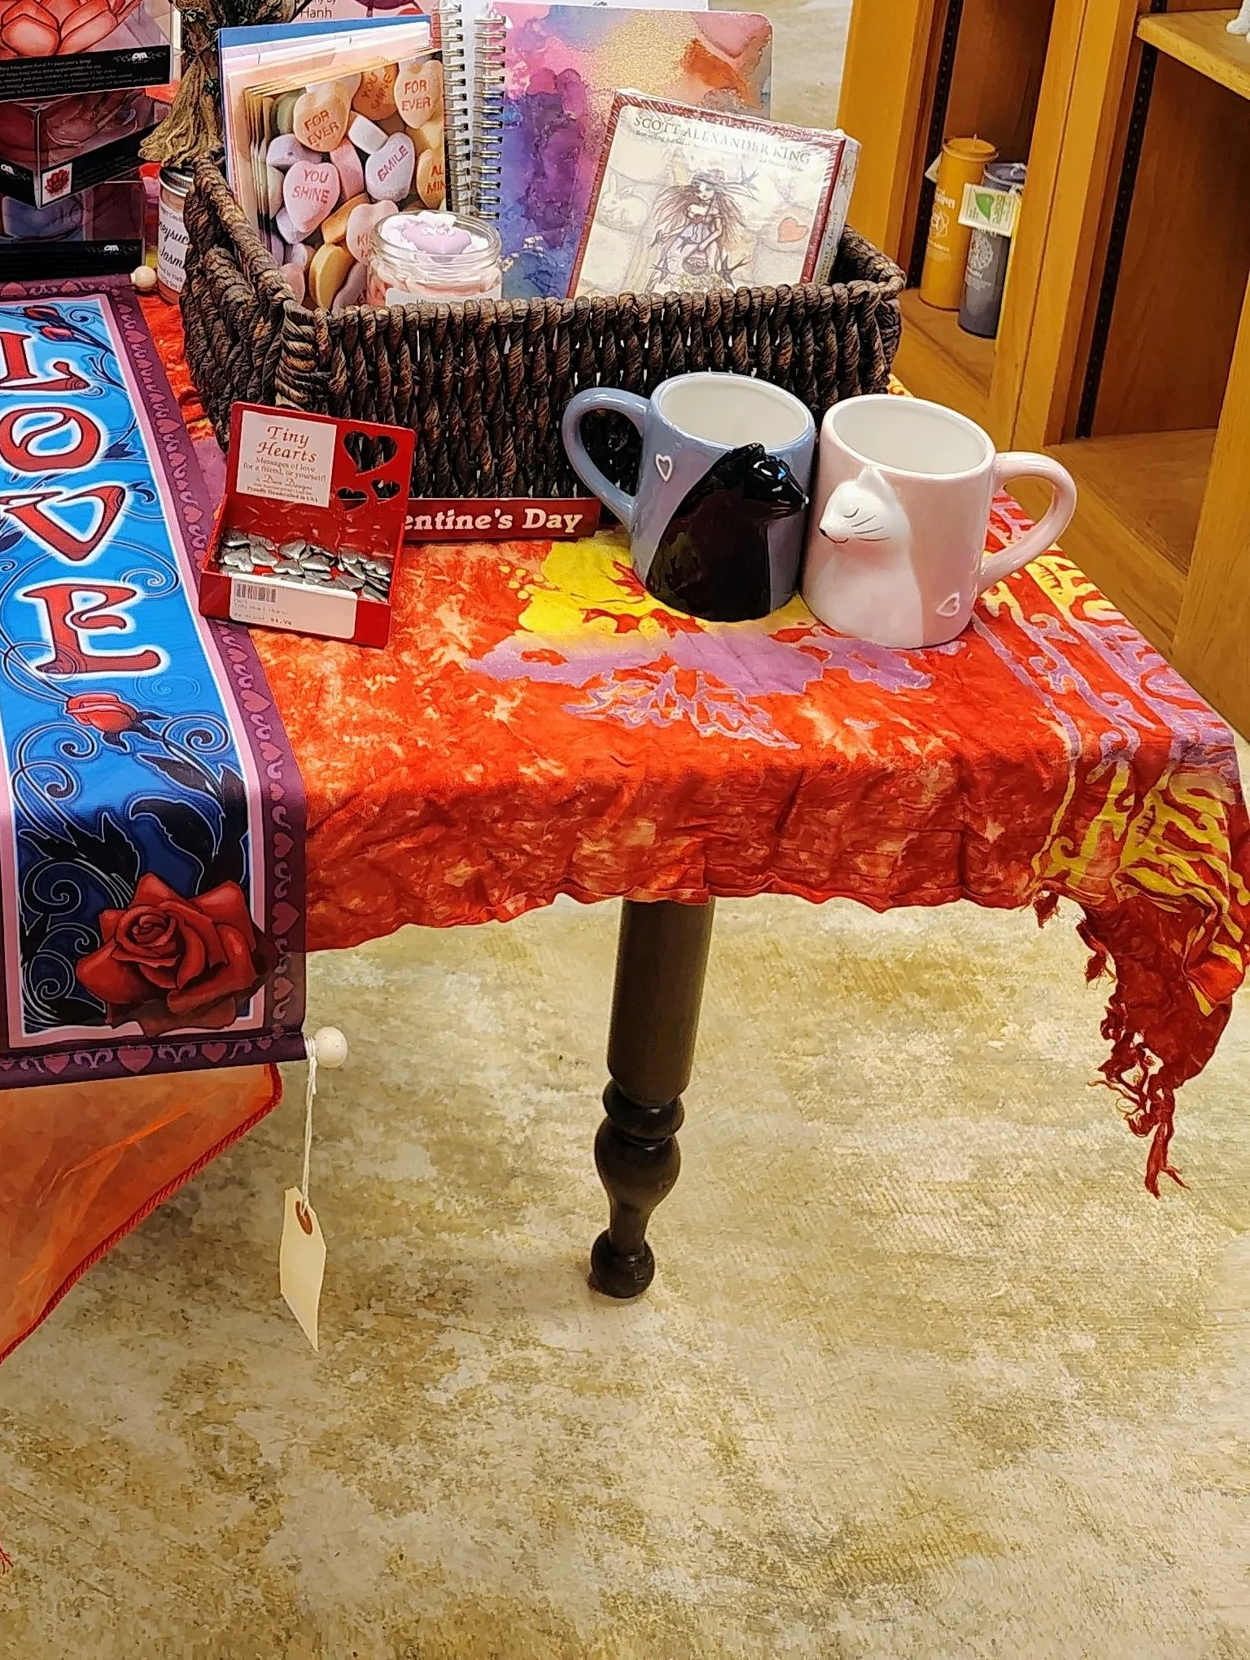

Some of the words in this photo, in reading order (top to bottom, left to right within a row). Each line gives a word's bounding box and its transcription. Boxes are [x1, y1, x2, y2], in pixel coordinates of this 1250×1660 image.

[300, 7, 333, 18] Hanh
[404, 80, 427, 95] FOR
[401, 96, 431, 111] EVER
[303, 109, 331, 131] FOR
[307, 122, 340, 145] EVER
[634, 116, 681, 135] SCOTT
[682, 127, 770, 155] ALEXANDER
[773, 147, 811, 164] KING
[302, 168, 329, 184] YOU
[291, 186, 331, 204] SHINE
[267, 425, 310, 449] Tiny
[257, 441, 317, 463] Hearts
[300, 464, 315, 472] love
[404, 507, 513, 532] entine's
[521, 508, 584, 534] Day
